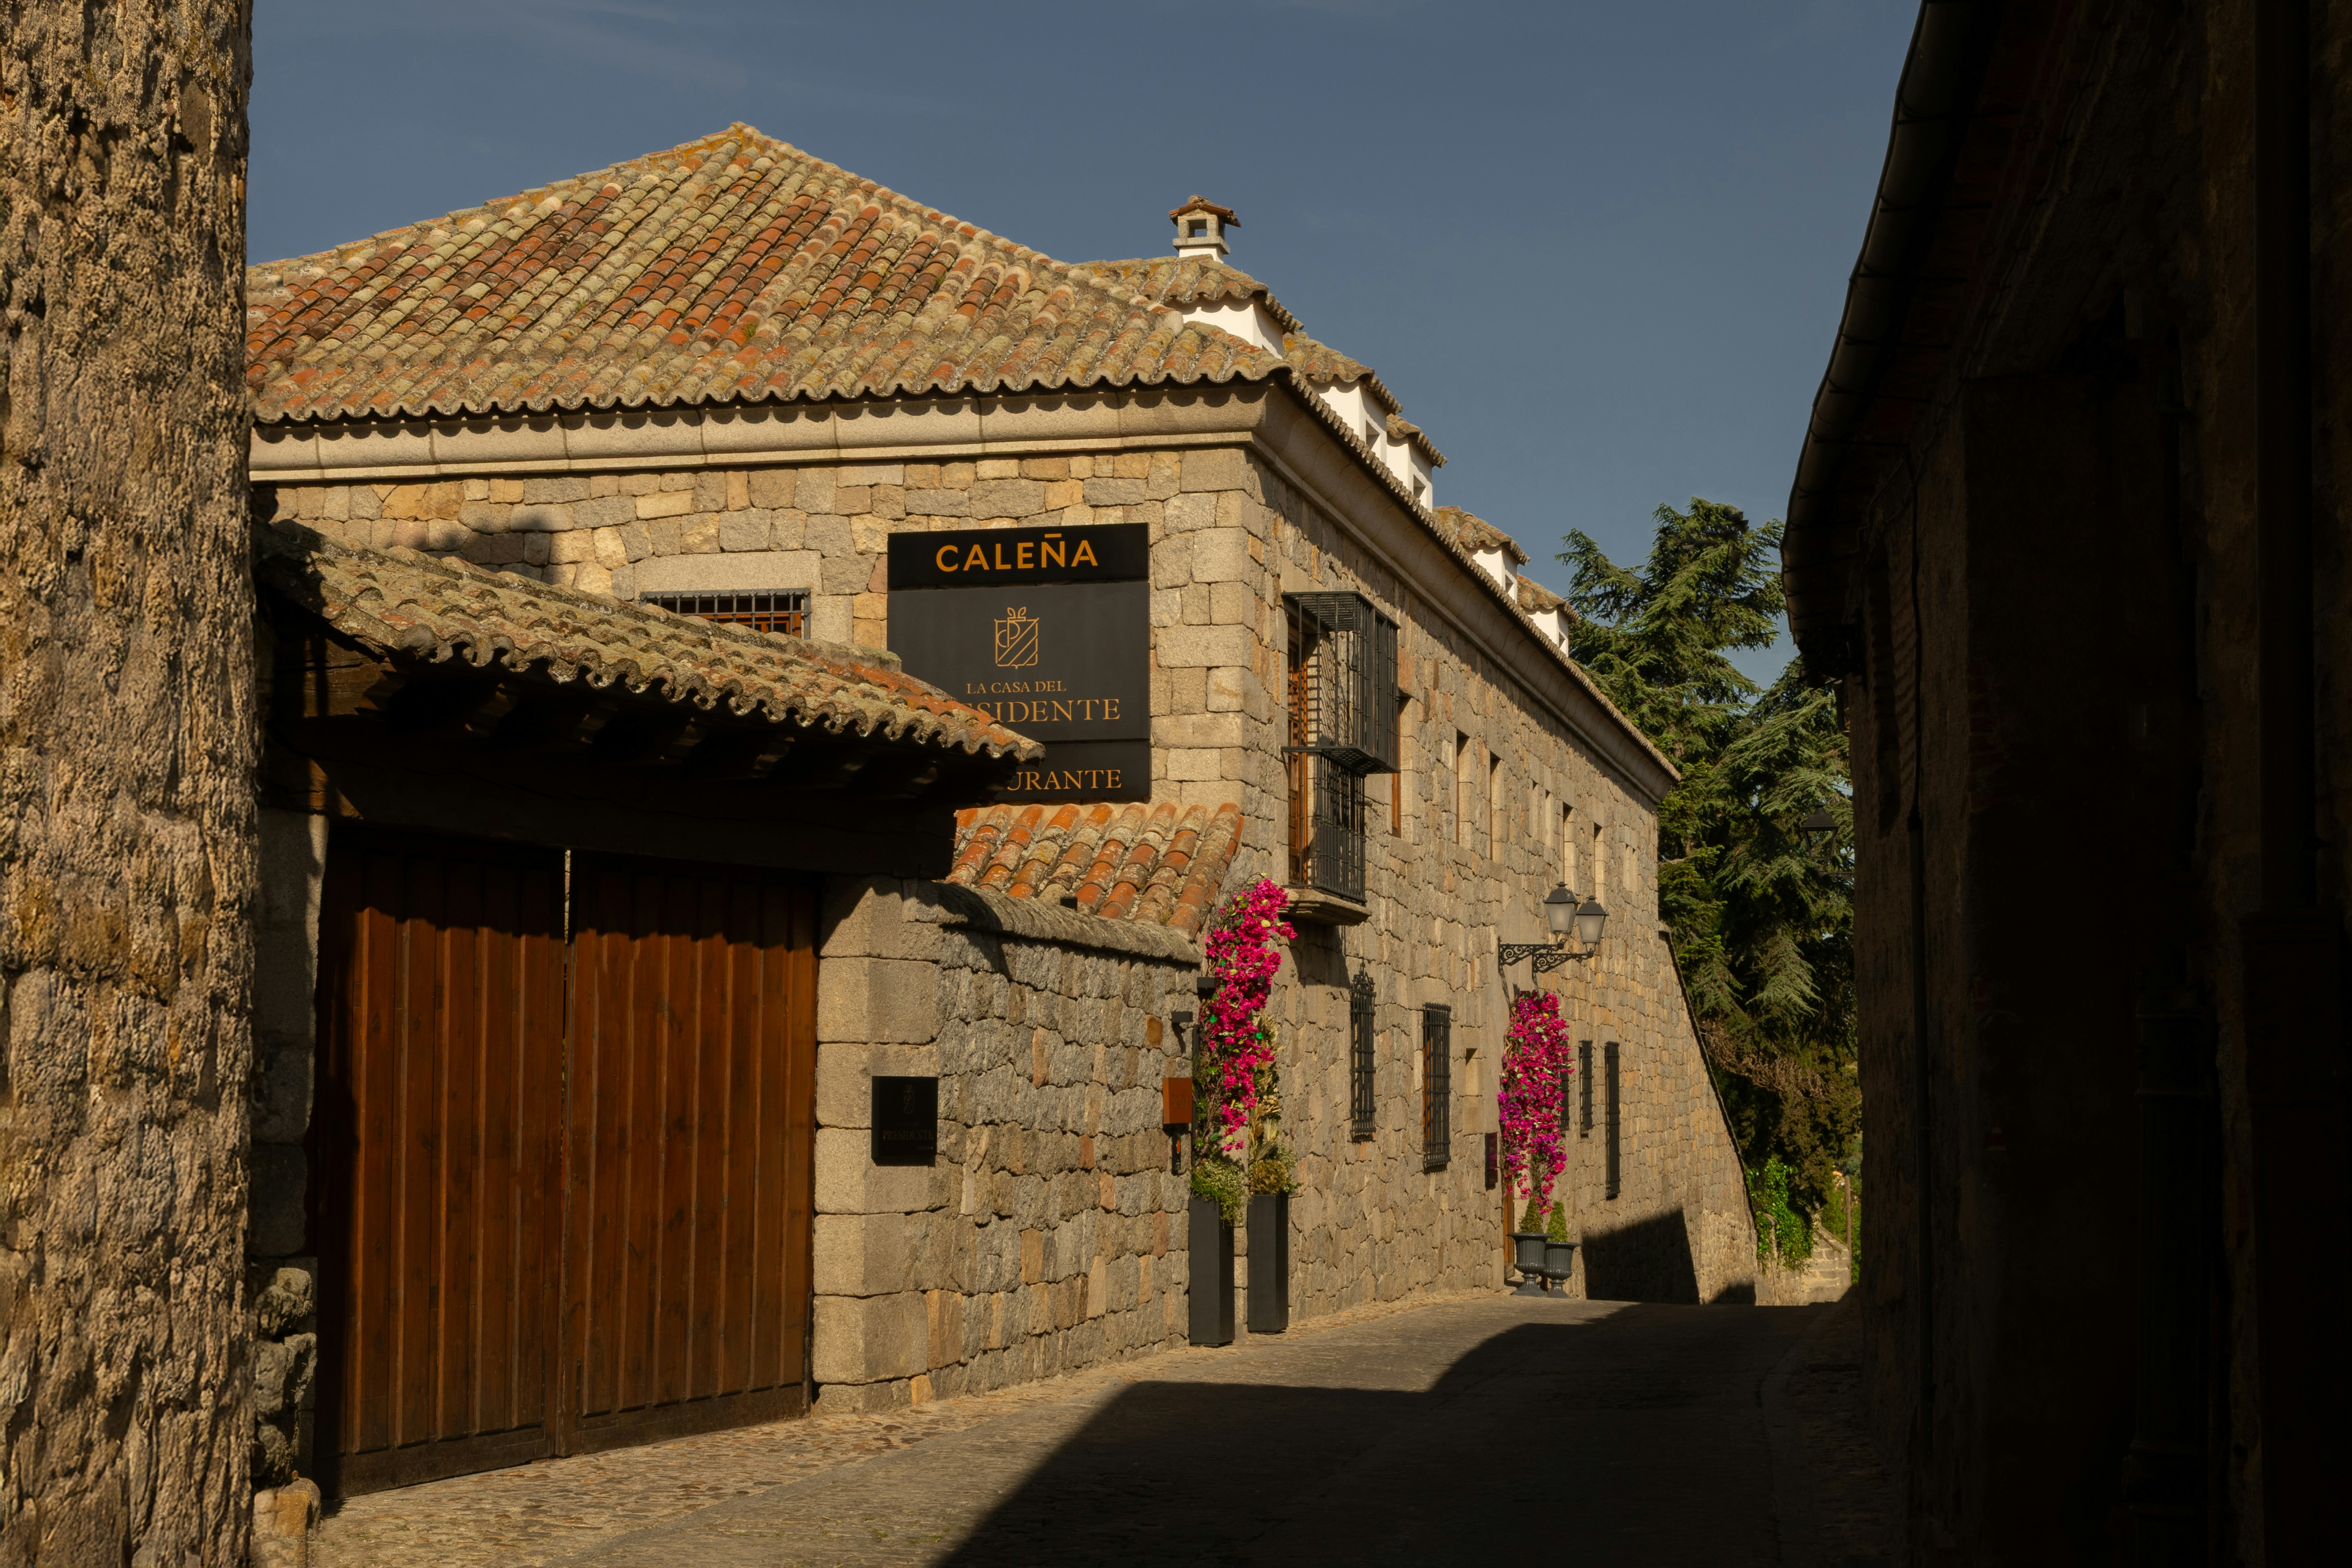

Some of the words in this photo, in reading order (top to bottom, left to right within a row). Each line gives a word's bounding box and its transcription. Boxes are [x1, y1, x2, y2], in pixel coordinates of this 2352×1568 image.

[936, 533, 1098, 572] CALEÑA
[967, 683, 987, 694] LA
[991, 681, 1031, 694] CASA
[1035, 680, 1067, 692] DEL
[961, 699, 1120, 723] SIDENTE
[1007, 769, 1122, 791] URANTE
